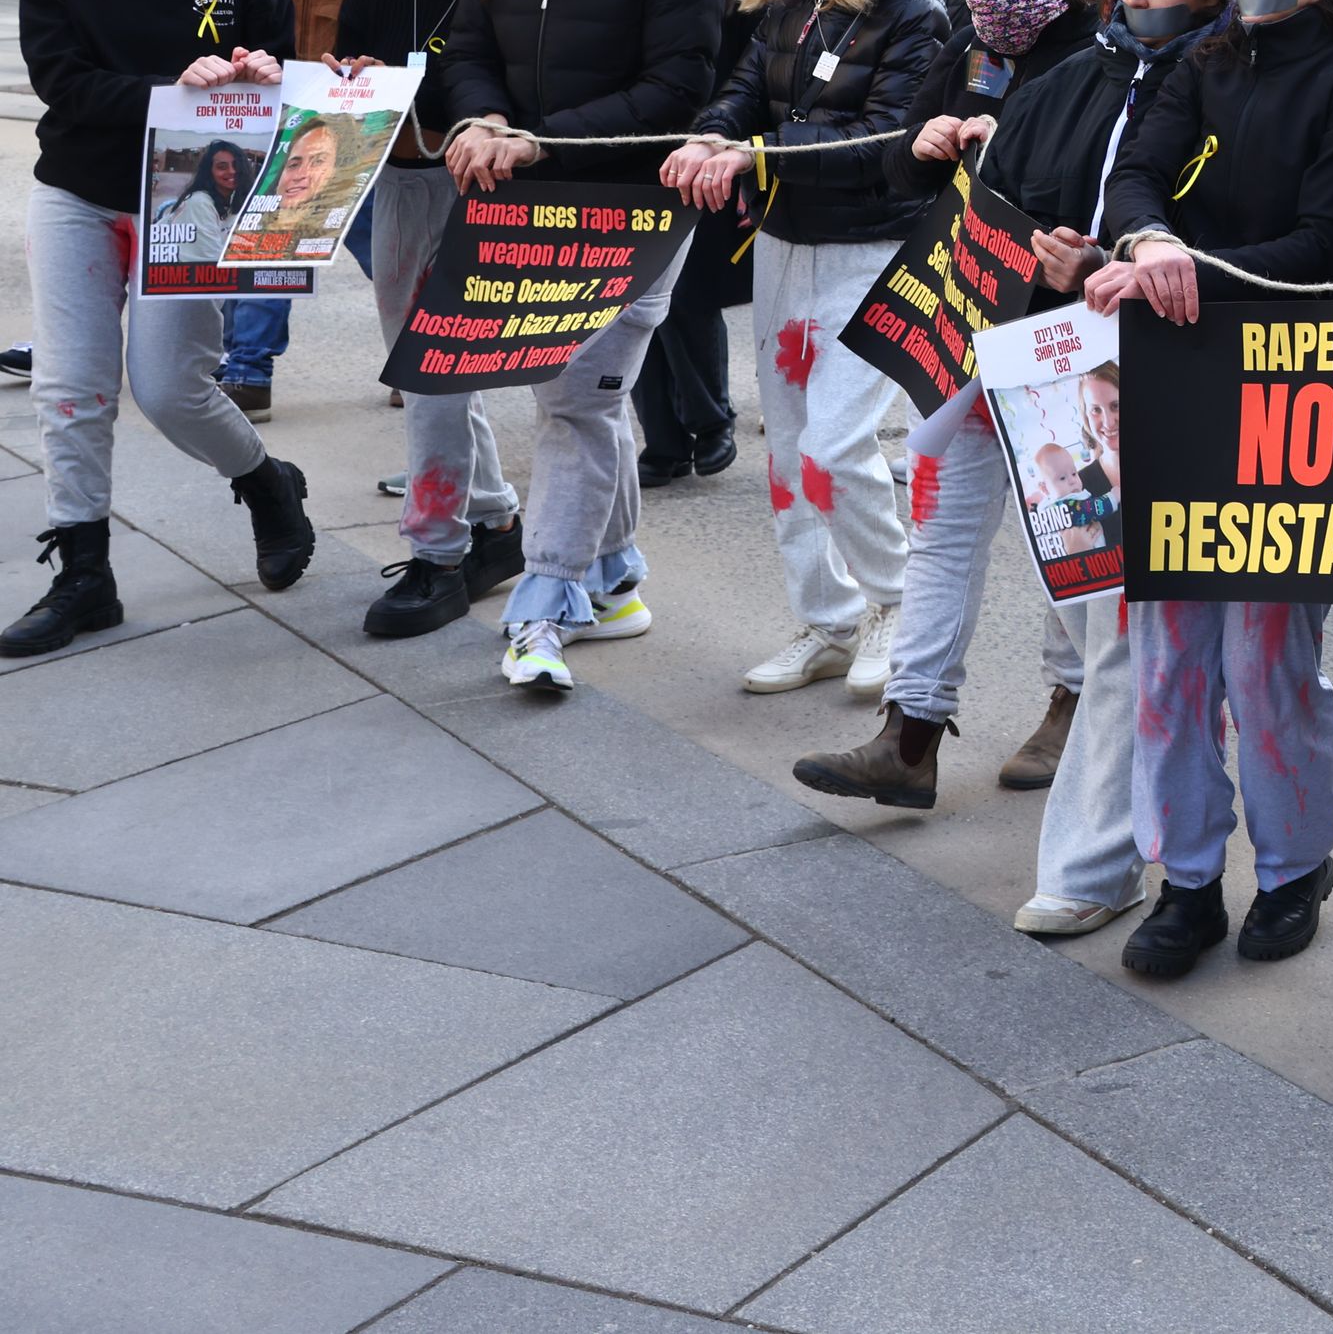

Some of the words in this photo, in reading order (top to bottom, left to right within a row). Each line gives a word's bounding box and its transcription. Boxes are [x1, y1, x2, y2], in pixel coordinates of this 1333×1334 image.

[328, 88, 348, 98] INBAR
[348, 88, 375, 98] HAYMAN
[196, 106, 217, 117] EDEN
[219, 106, 273, 117] YERUSHALMI
[225, 118, 244, 130] (24)
[247, 195, 282, 212] BRING
[238, 213, 263, 230] HER
[465, 199, 529, 227] Hamas
[532, 204, 577, 229] uses
[581, 207, 626, 233] rape
[631, 210, 655, 231] as
[658, 210, 672, 231] a
[150, 223, 196, 244] BRING
[149, 244, 179, 263] HER
[478, 241, 554, 268] weapon
[557, 243, 577, 266] of
[580, 242, 635, 266] terror.
[148, 266, 193, 284] HOME
[195, 266, 238, 284] NOW!
[254, 277, 282, 286] FAMILIES
[284, 277, 307, 286] FORUM
[464, 275, 513, 302] Since
[517, 278, 586, 303] October
[582, 278, 602, 302] 7,
[599, 275, 634, 299] 136
[886, 264, 940, 319] immer
[410, 309, 503, 341] hostages
[501, 314, 517, 339] in
[517, 315, 562, 337] Gaza
[556, 313, 588, 333] are
[584, 304, 622, 330] still
[863, 302, 907, 343] den
[1054, 321, 1075, 340] שירי
[1034, 341, 1057, 362] SHIRI
[1056, 336, 1082, 357] BIBAS
[420, 348, 455, 374] the
[454, 350, 503, 375] hands
[503, 350, 521, 372] of
[1054, 356, 1072, 375] (32)
[1028, 503, 1072, 536] BRING
[1036, 532, 1067, 561] HER
[1045, 558, 1084, 588] HOME
[1084, 544, 1124, 581] NOW!
